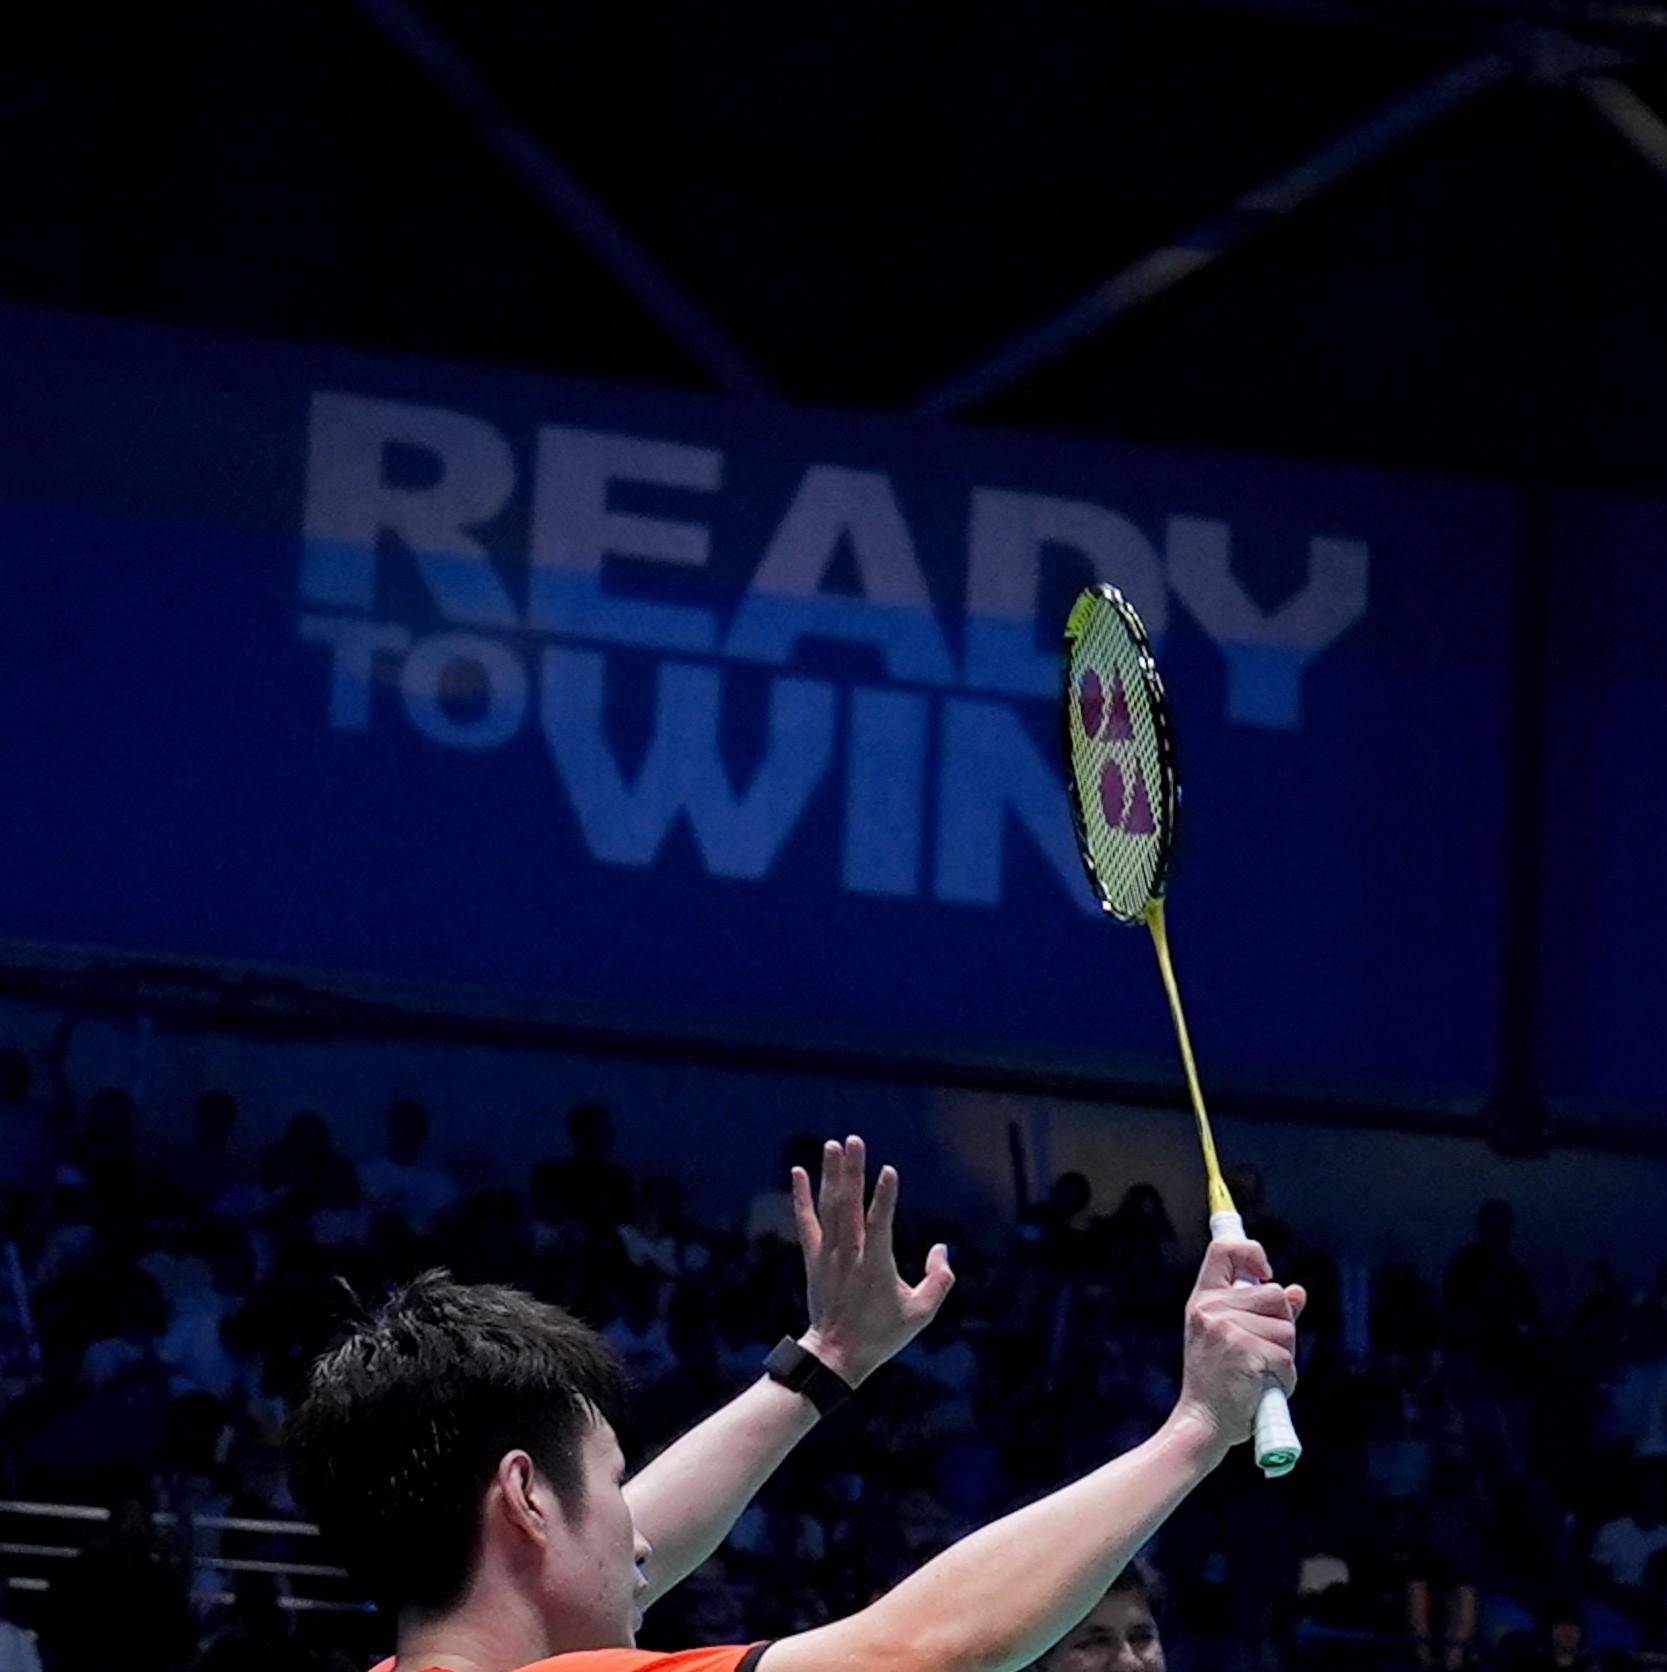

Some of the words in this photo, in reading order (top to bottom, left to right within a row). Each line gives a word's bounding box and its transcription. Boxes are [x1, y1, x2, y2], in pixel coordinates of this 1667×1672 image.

[298, 390, 1370, 730] READY
[299, 614, 528, 750] TO
[537, 633, 1108, 918] WIN
